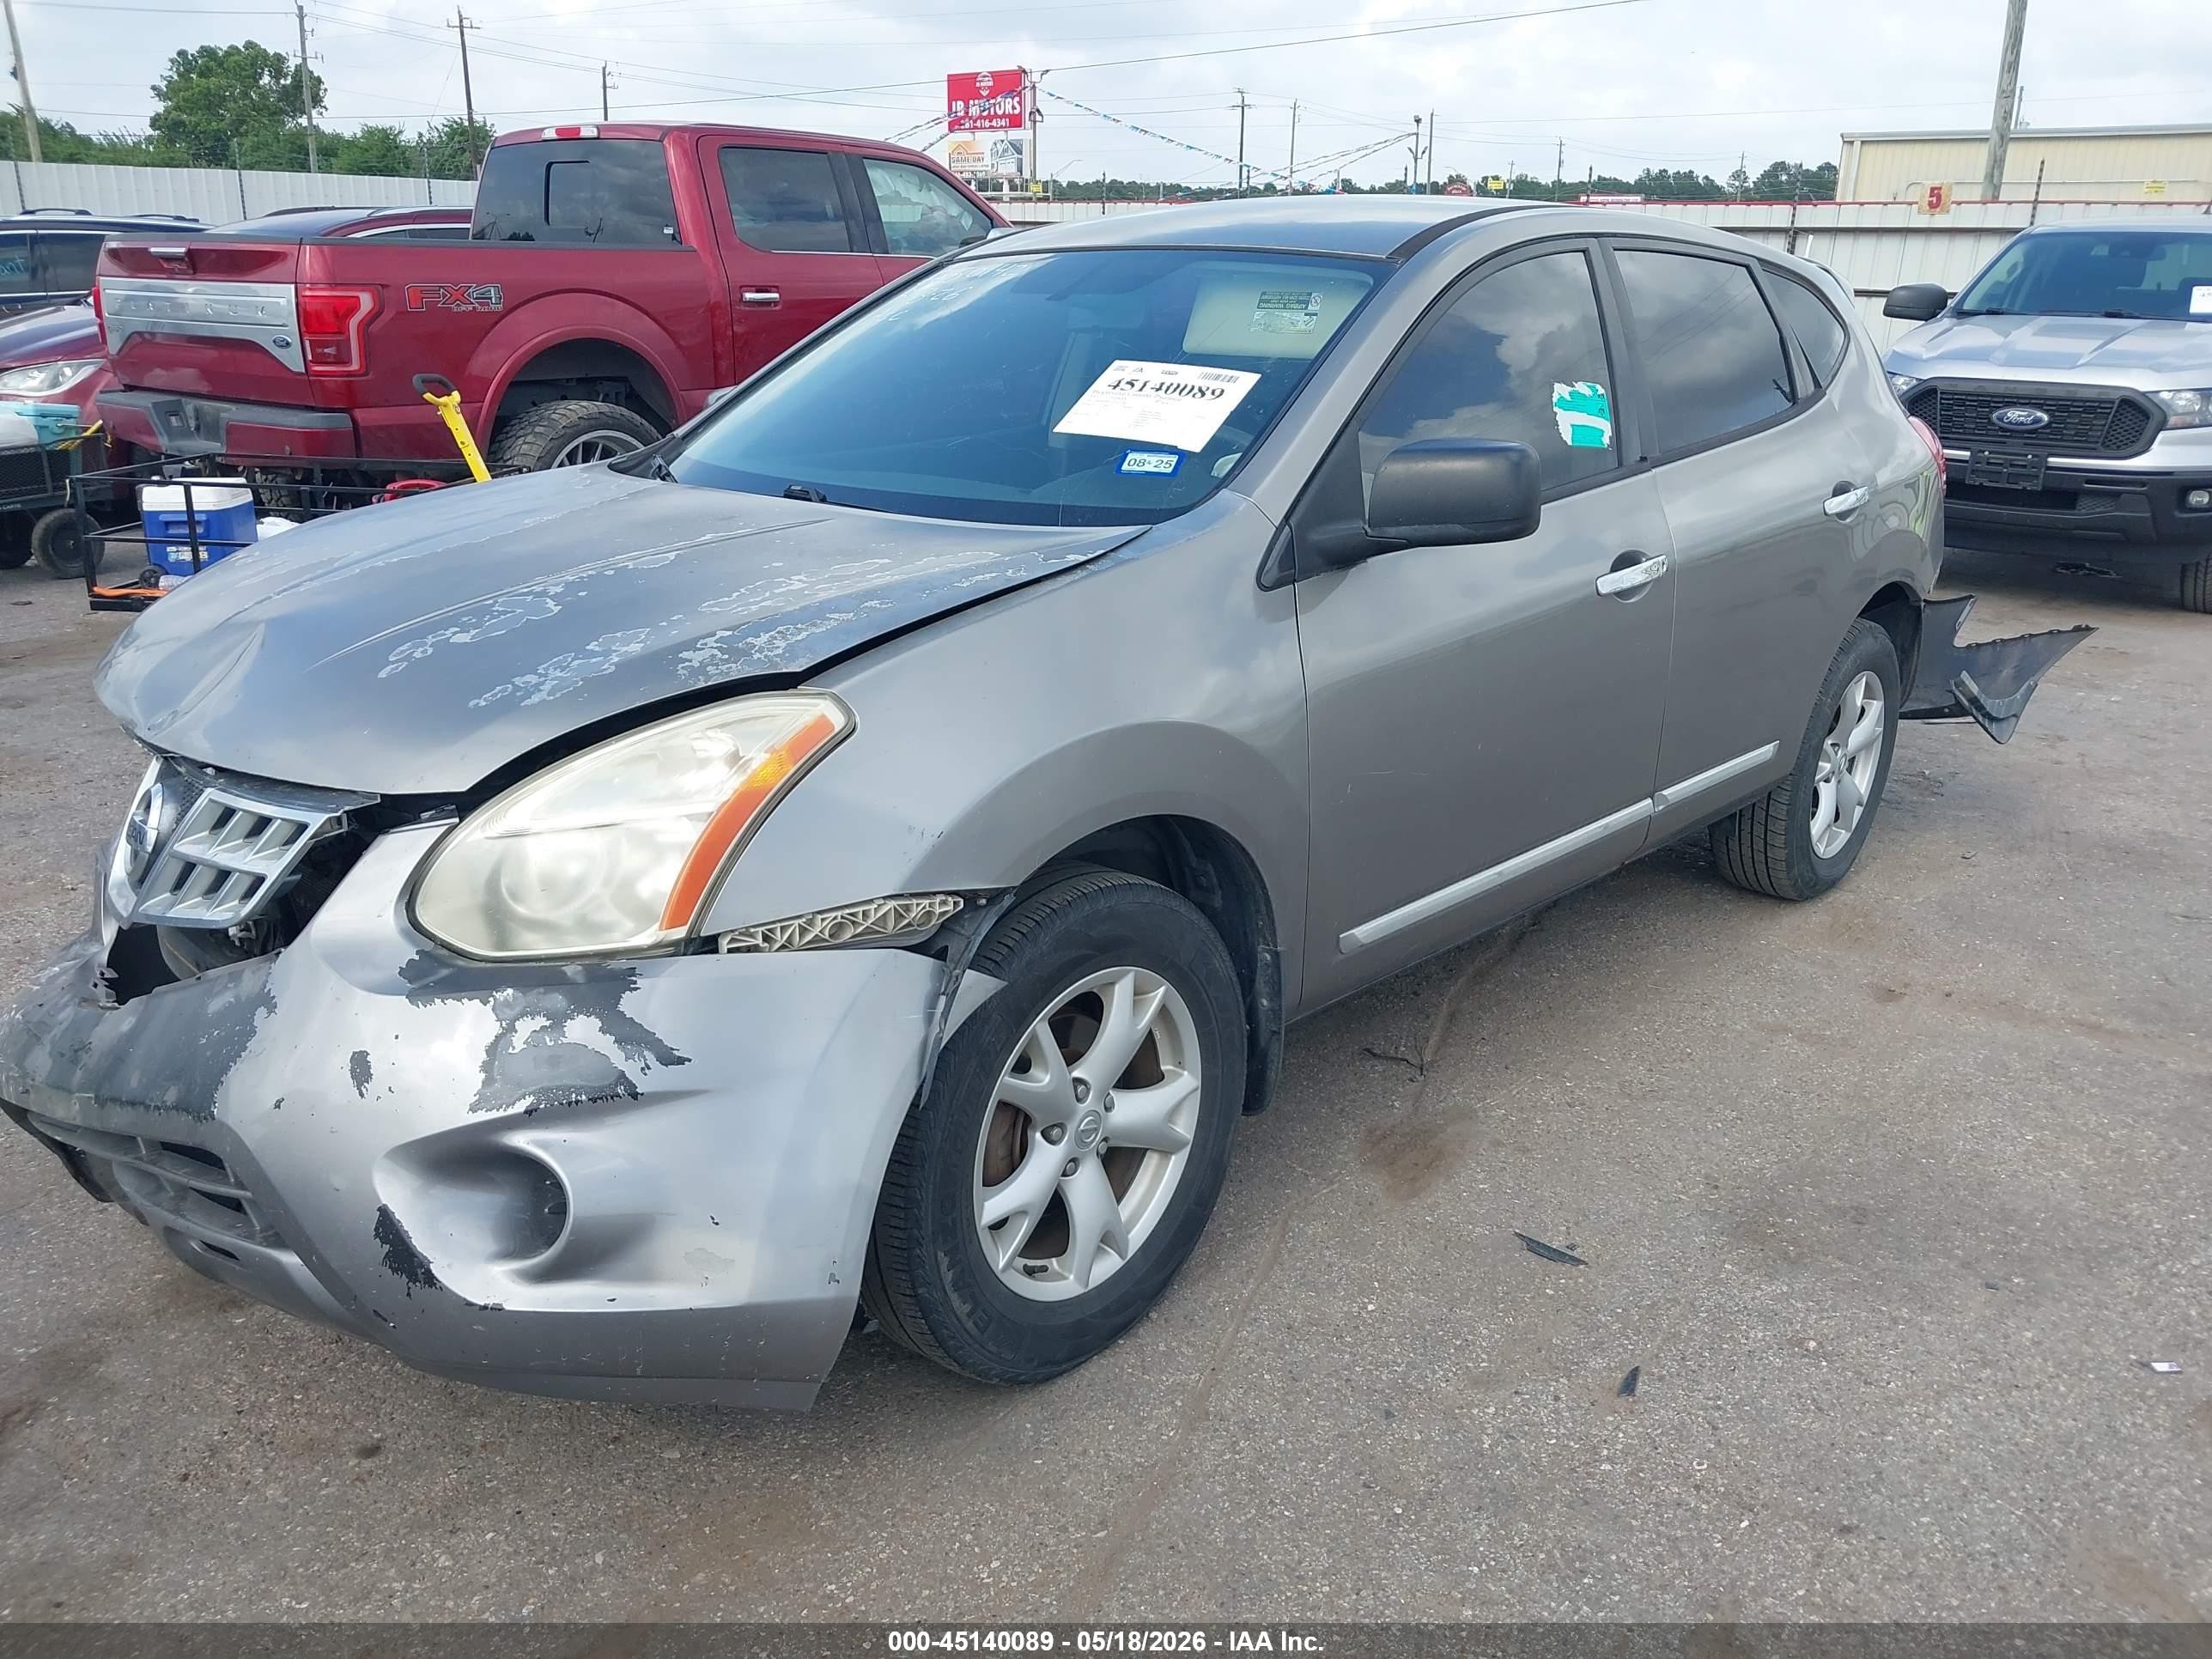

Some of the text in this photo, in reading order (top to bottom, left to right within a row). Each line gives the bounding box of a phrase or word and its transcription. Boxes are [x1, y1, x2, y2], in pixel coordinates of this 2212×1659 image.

[1928, 186, 1942, 210] 5
[405, 283, 503, 311] FX4
[114, 299, 268, 318] PLATINUM
[1107, 378, 1224, 401] 45140089
[2003, 410, 2035, 424] Ford
[1127, 458, 1175, 470] 08 25
